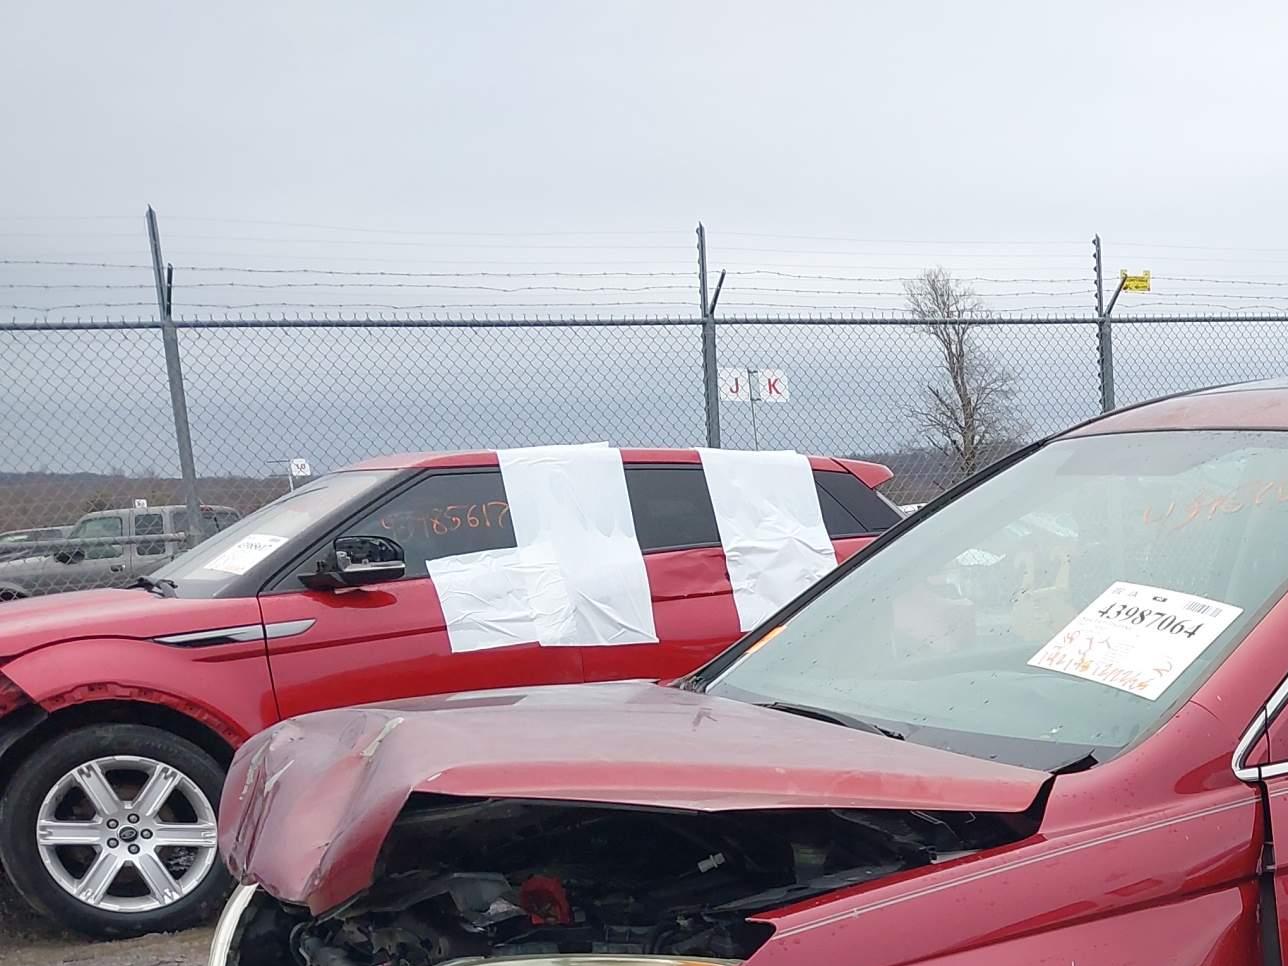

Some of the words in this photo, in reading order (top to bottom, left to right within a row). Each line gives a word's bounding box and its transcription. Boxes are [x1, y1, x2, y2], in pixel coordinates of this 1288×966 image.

[729, 377, 740, 394] J
[767, 377, 782, 395] K
[1098, 602, 1204, 639] 43987064
